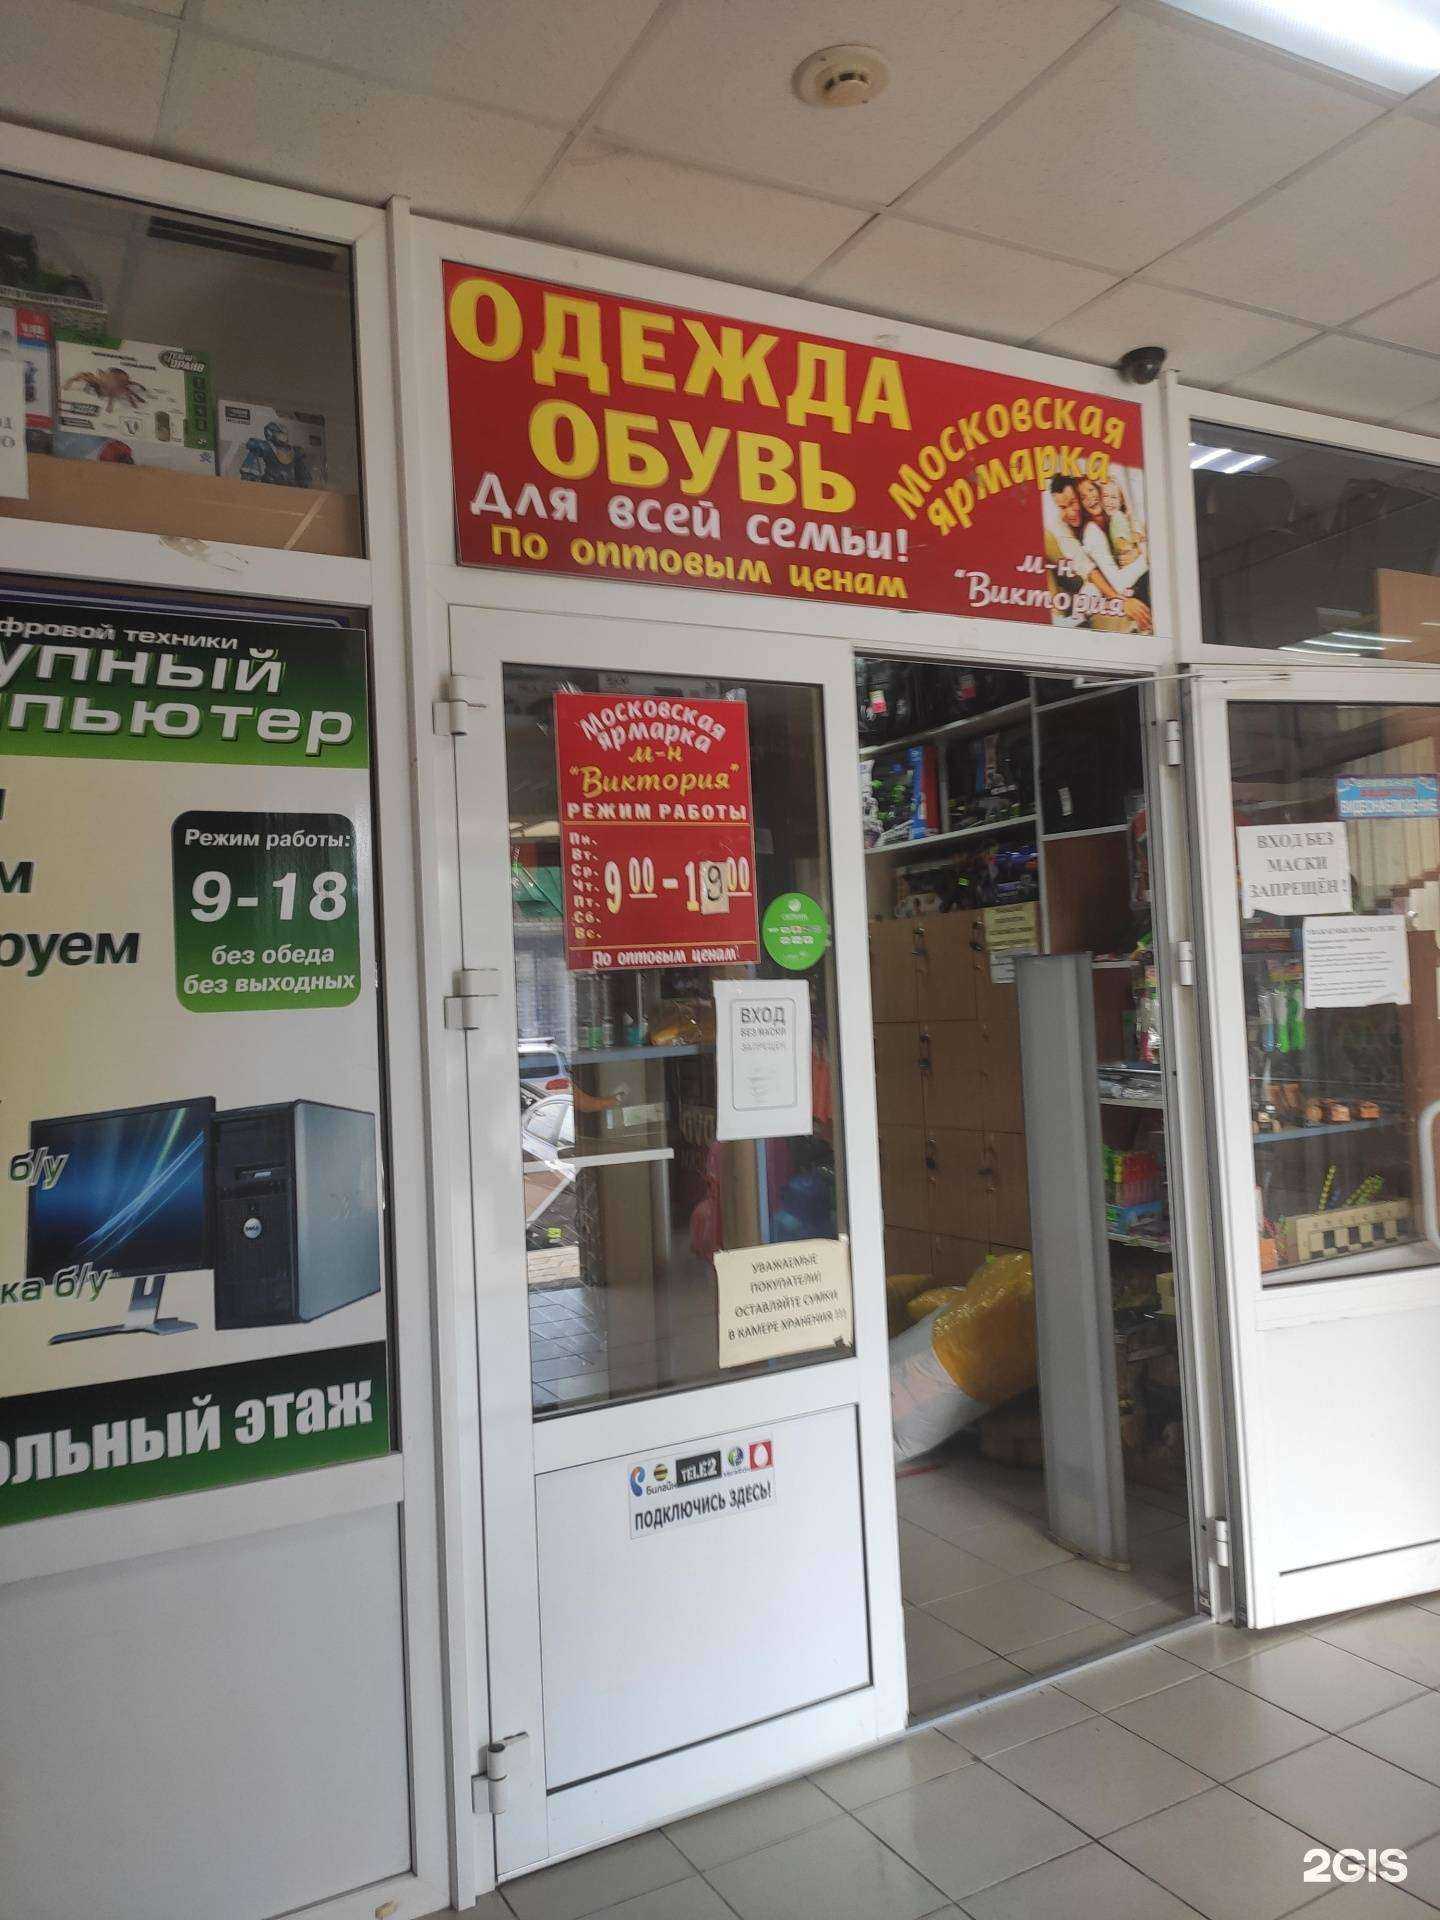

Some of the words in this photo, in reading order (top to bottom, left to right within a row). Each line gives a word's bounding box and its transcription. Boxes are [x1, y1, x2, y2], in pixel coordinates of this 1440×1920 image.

[449, 278, 911, 434] ОДЕЖДА
[528, 398, 856, 514] ОБУВЬ
[888, 396, 1126, 520] Московская
[927, 445, 1110, 536] ярмарка
[470, 471, 579, 523] Для
[608, 494, 722, 540] всей
[745, 511, 909, 563] семьи!
[490, 522, 549, 560] По
[570, 536, 773, 585] оптовым
[788, 563, 909, 599] ценам
[125, 628, 239, 651] техники
[6, 692, 354, 757] пьютер
[578, 700, 727, 742] Московская
[597, 721, 712, 754] ярмарка
[628, 746, 684, 764] м-н
[566, 802, 651, 820] РЕЖИМ
[658, 803, 747, 821] РАБОТЫ
[184, 828, 260, 849] Режим
[265, 832, 351, 851] работы:
[569, 831, 598, 846] Пн.
[1256, 834, 1303, 849] ВХОД
[1304, 831, 1334, 846] БЕЗ
[571, 847, 598, 861] Вт.
[1266, 856, 1329, 873] МАСКИ
[571, 863, 599, 879] Ср.
[190, 870, 348, 923] 9-18
[573, 894, 600, 908] Пт.
[573, 910, 601, 924] Сб.
[574, 926, 602, 940] Вс.
[211, 945, 255, 966] без
[261, 943, 335, 967] обеда
[592, 950, 612, 968] По
[617, 949, 687, 966] оптовым
[183, 975, 228, 995] без
[234, 972, 356, 995] выходных
[741, 1006, 786, 1025] ВХОД
[9, 1147, 70, 1190] б/у
[751, 1253, 819, 1275] УВАЖАЕМЫЕ
[54, 1262, 112, 1302] б/у
[734, 1295, 800, 1318] ОСТАВЛЯЙТЕ
[802, 1288, 839, 1306] СУМКИ
[728, 1328, 736, 1341] В
[737, 1319, 780, 1338] КАМЕРЕ
[781, 1310, 833, 1331] ХРАНЕНИЯ
[234, 1379, 373, 1445] этаж
[634, 1491, 726, 1531] ПОДКЛЮЧИСЬ
[729, 1479, 772, 1510] ЗДЕСЬ!
